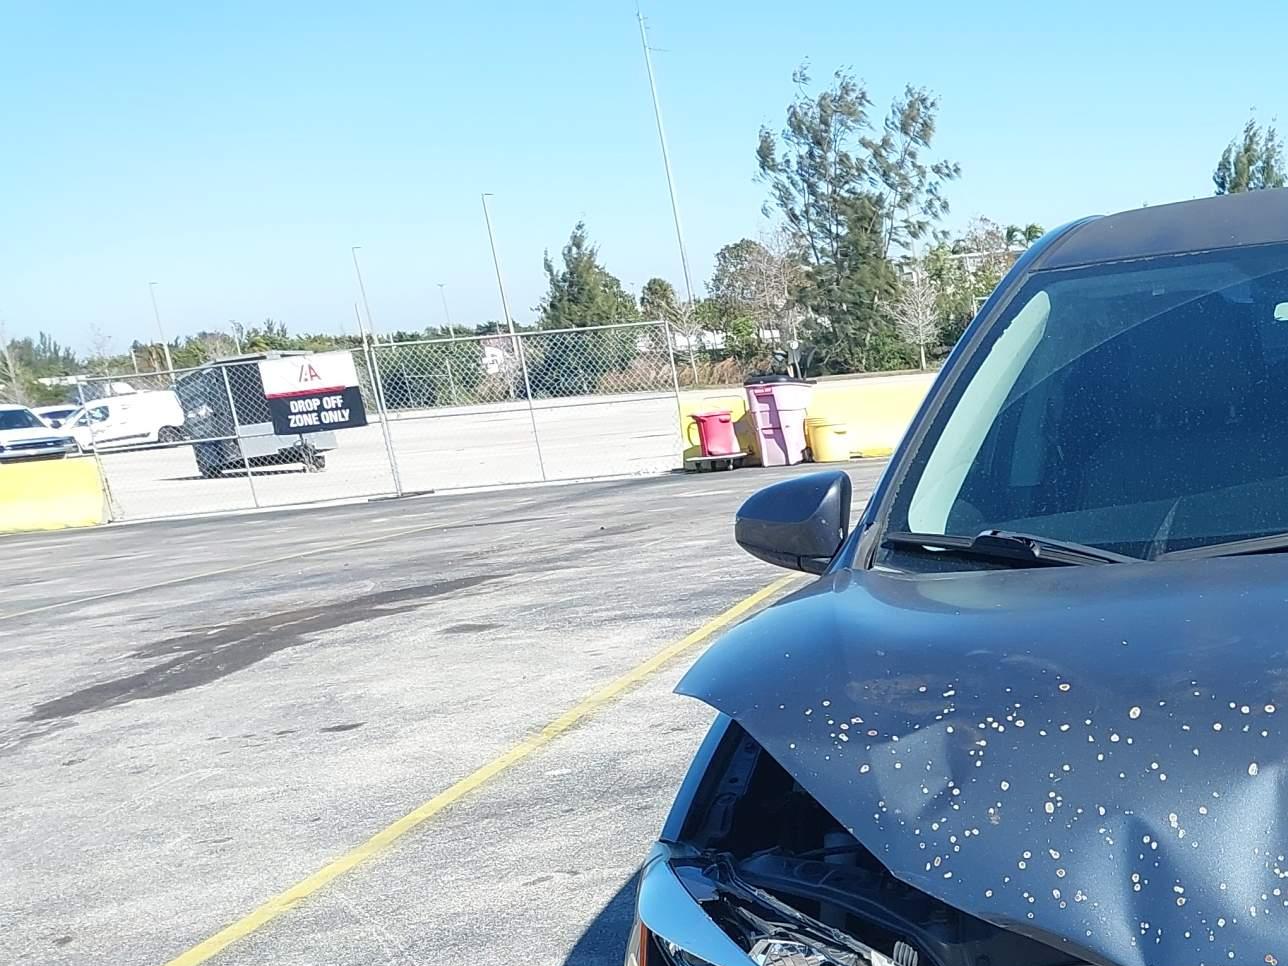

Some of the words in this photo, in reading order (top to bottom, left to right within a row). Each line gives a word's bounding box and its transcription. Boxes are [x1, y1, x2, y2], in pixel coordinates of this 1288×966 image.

[289, 398, 321, 413] DROP
[322, 395, 344, 409] OFF
[288, 411, 320, 428] ZONE
[320, 408, 350, 424] ONLY
